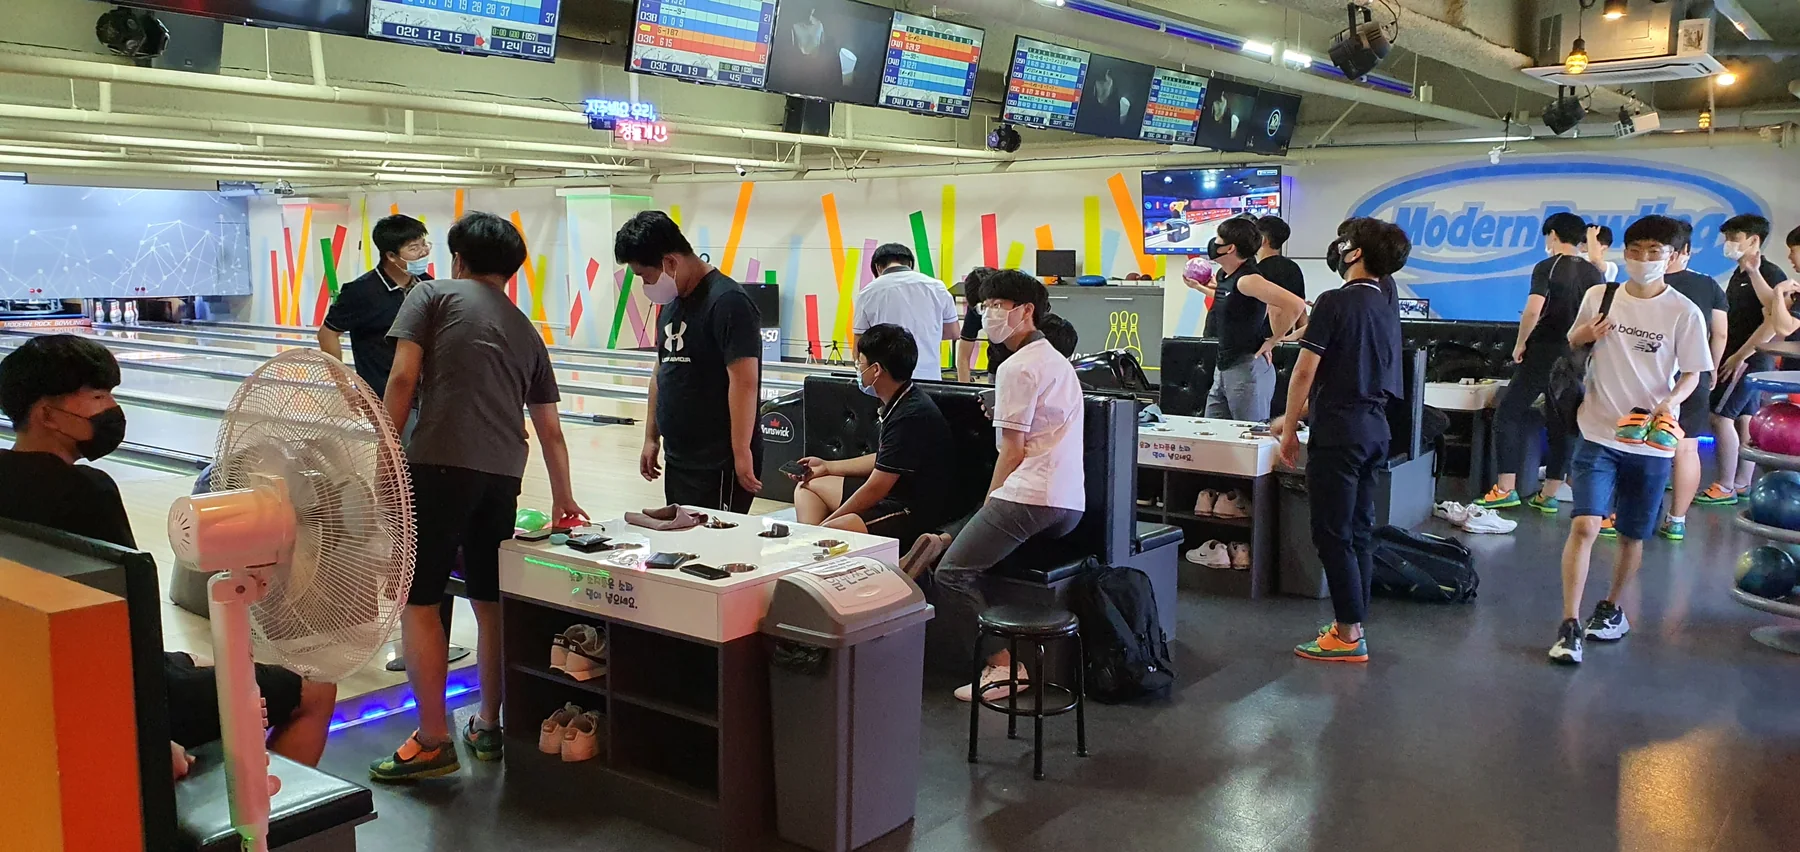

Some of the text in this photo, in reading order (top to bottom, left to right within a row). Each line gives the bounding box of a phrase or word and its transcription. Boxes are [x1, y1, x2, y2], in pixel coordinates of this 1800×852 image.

[544, 12, 555, 24] 37
[396, 26, 462, 44] 02C 12 15
[637, 34, 655, 44] 03C
[502, 40, 550, 54] 124 124
[650, 60, 667, 71] 03C
[730, 73, 762, 85] 45 45
[4, 320, 32, 328] MODERN
[1618, 324, 1664, 341] balance
